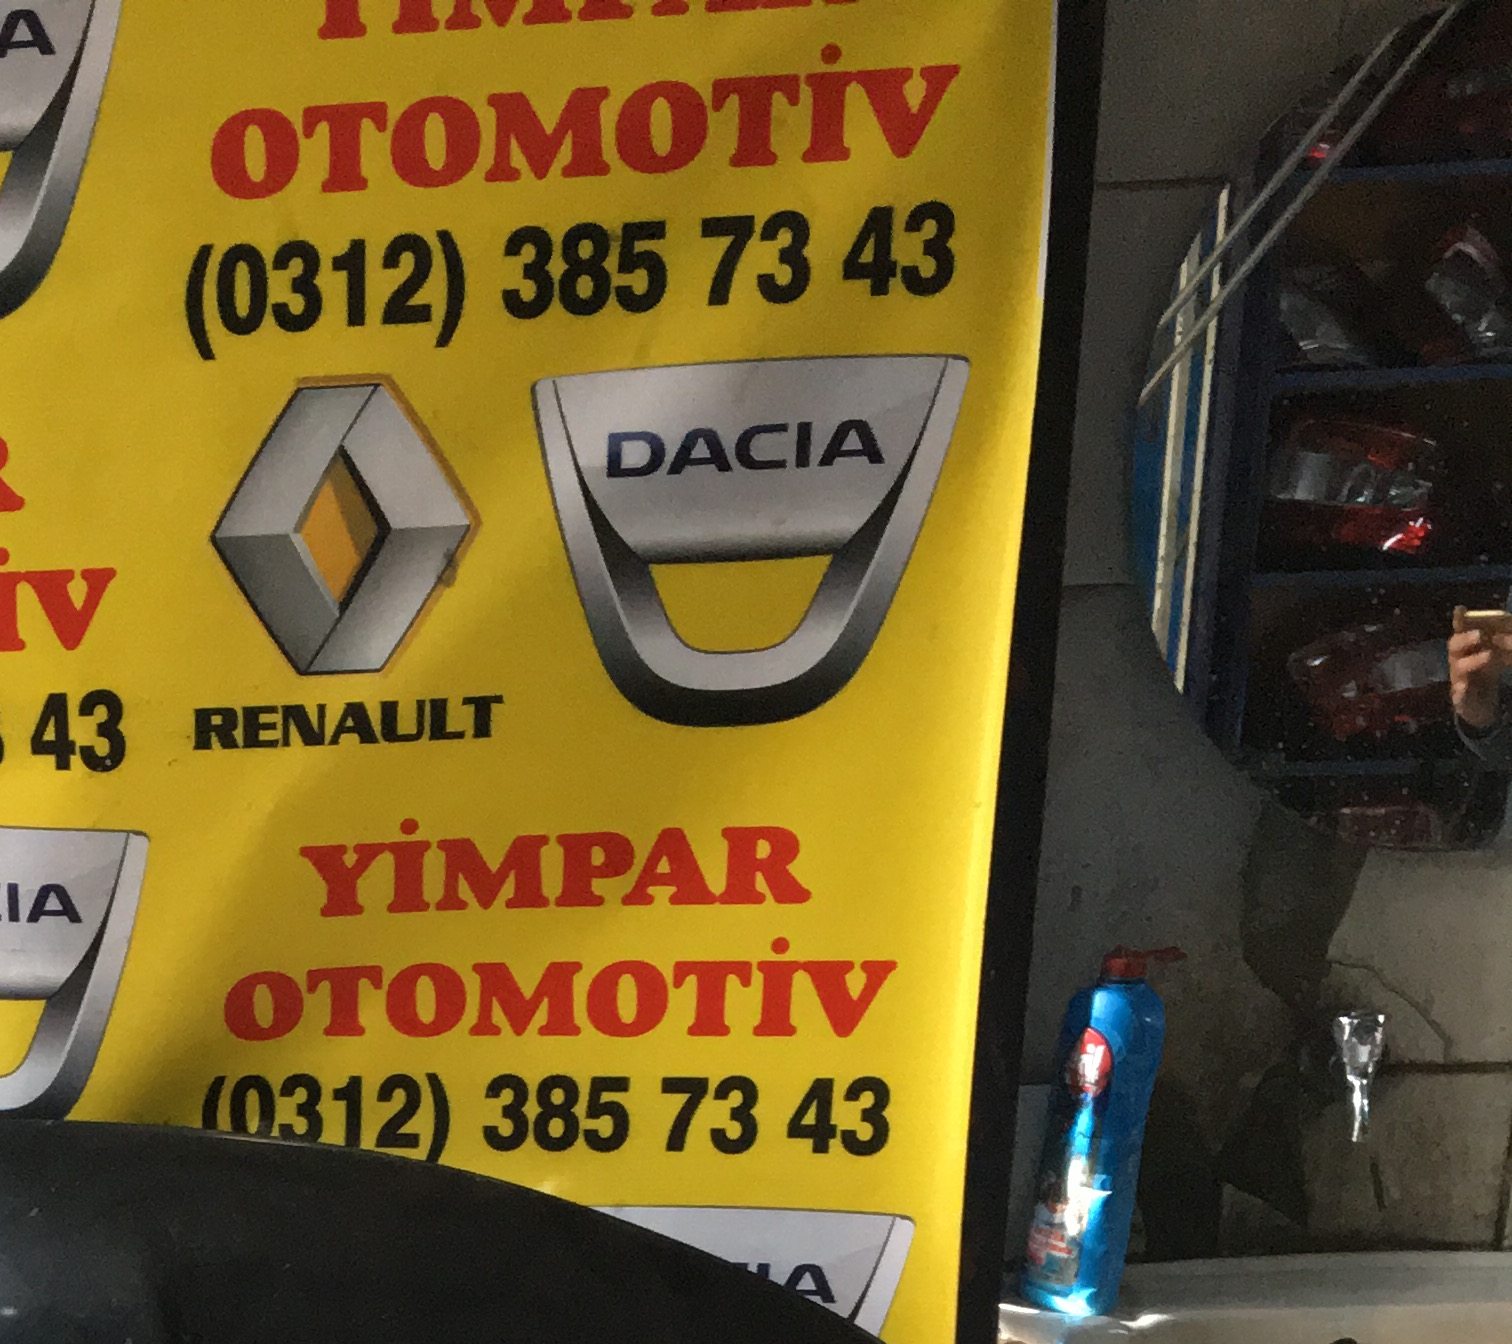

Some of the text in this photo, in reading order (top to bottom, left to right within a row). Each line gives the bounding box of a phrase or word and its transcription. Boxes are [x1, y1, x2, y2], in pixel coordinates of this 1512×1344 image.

[210, 43, 961, 200] OTOMOTİV
[184, 199, 957, 361] (0312) 385 73 43
[605, 418, 886, 479] DACIA
[30, 689, 127, 773] 43
[193, 694, 505, 751] RENAULT
[300, 818, 812, 918] YİMPAR
[224, 937, 898, 1042] OTOMOTİV
[201, 1072, 890, 1163] (0312) 385 73 43
